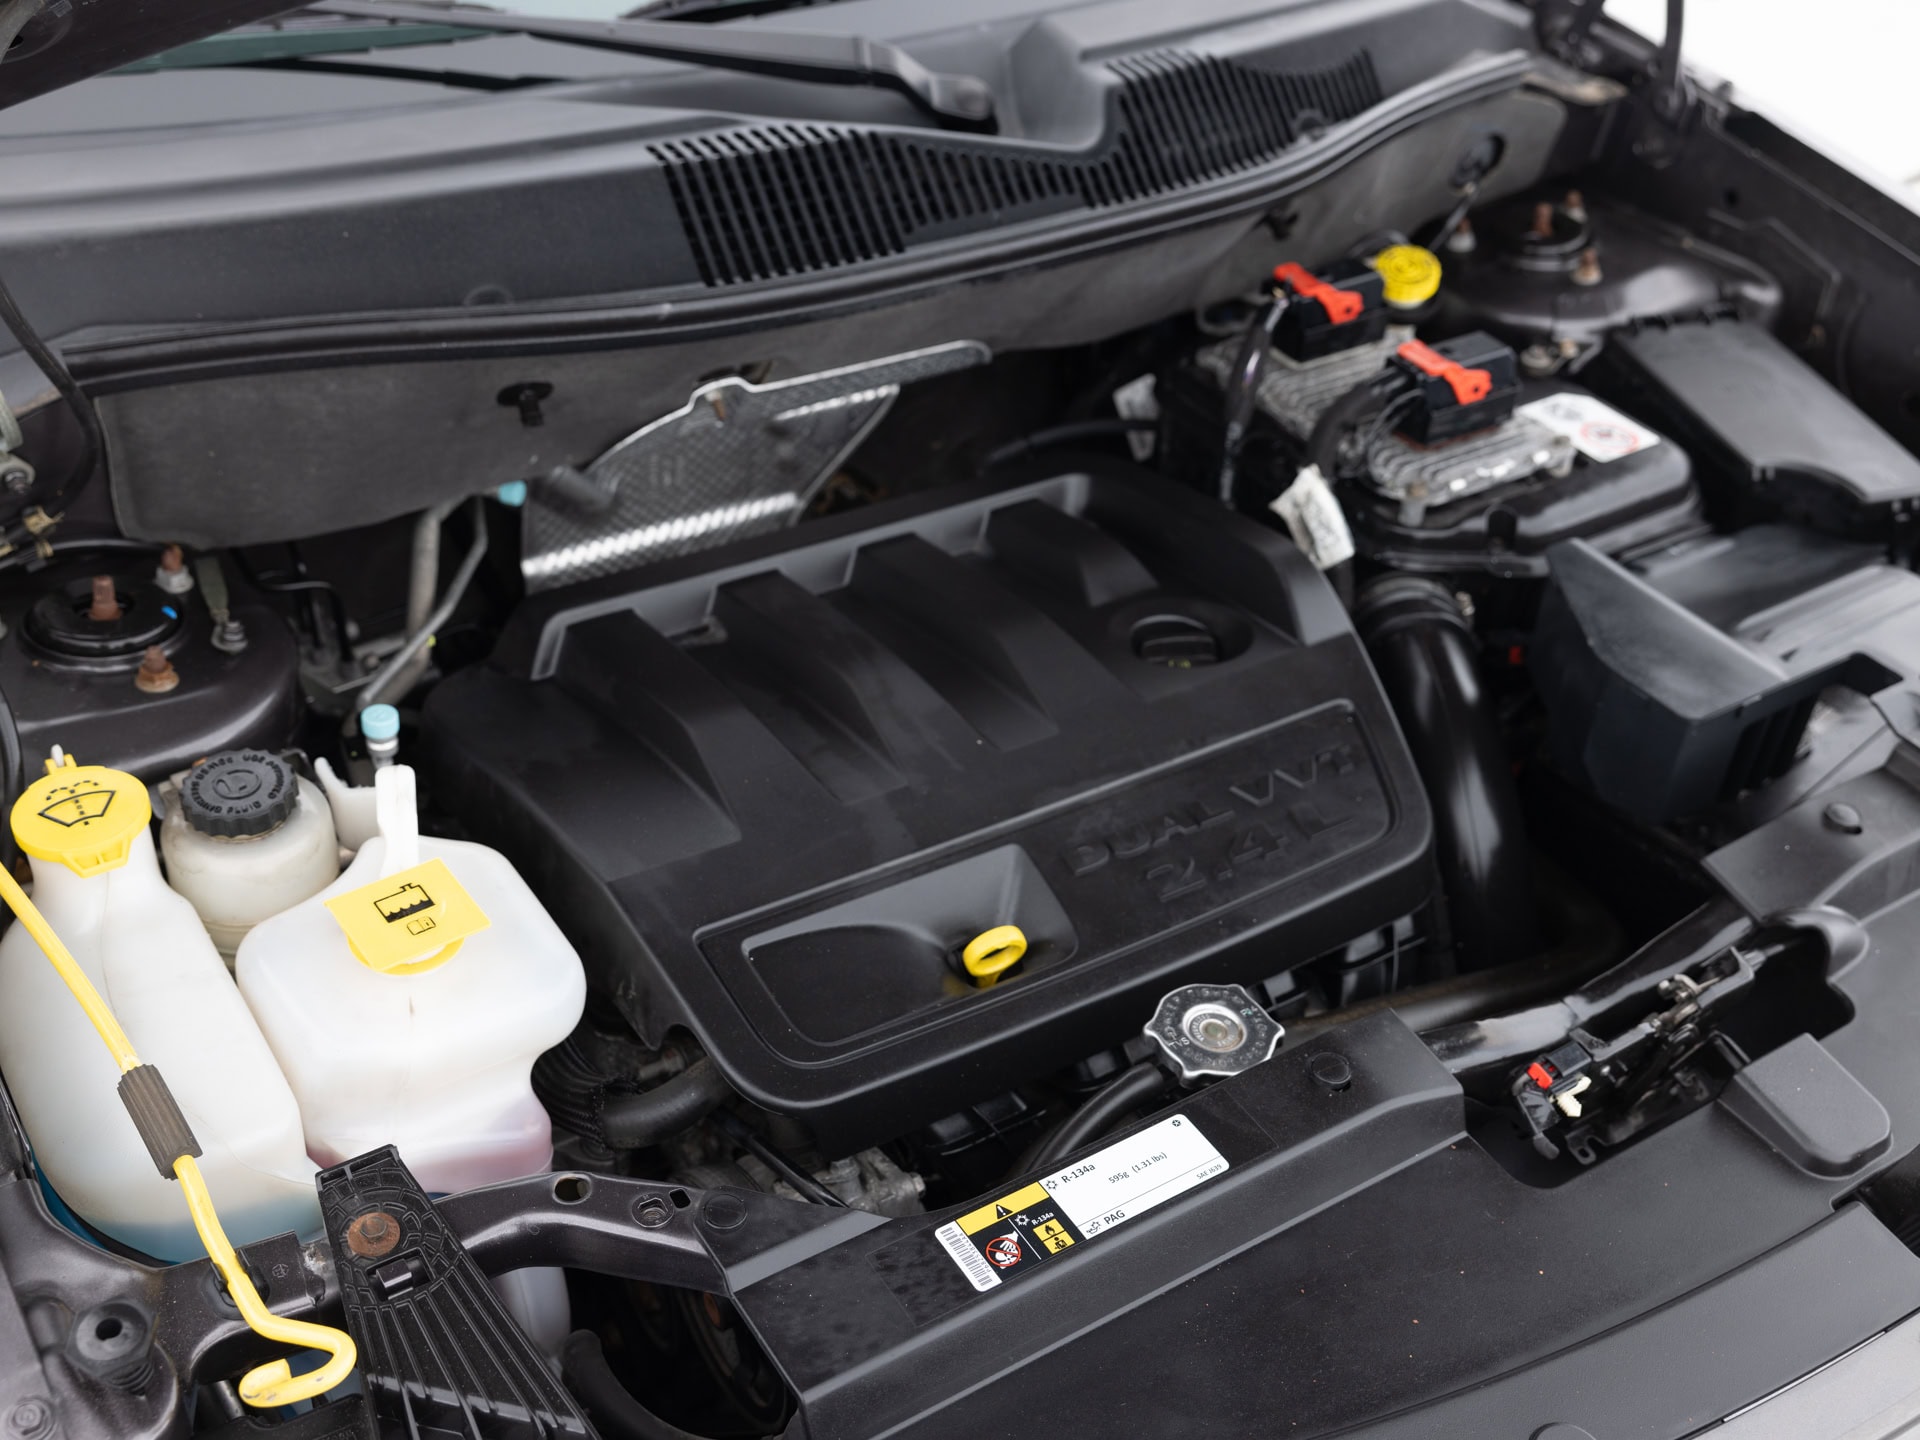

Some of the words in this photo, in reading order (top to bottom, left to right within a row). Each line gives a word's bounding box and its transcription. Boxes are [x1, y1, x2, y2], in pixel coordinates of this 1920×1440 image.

[1061, 799, 1236, 877] DUAL
[1146, 802, 1354, 903] 2.4L
[1061, 1164, 1096, 1183] R-134a
[1108, 1171, 1130, 1184] 595g
[1131, 1158, 1152, 1174] (1.31
[1150, 1151, 1168, 1163] lbs)
[1031, 1212, 1055, 1226] R-134a
[1103, 1209, 1126, 1225] PAG
